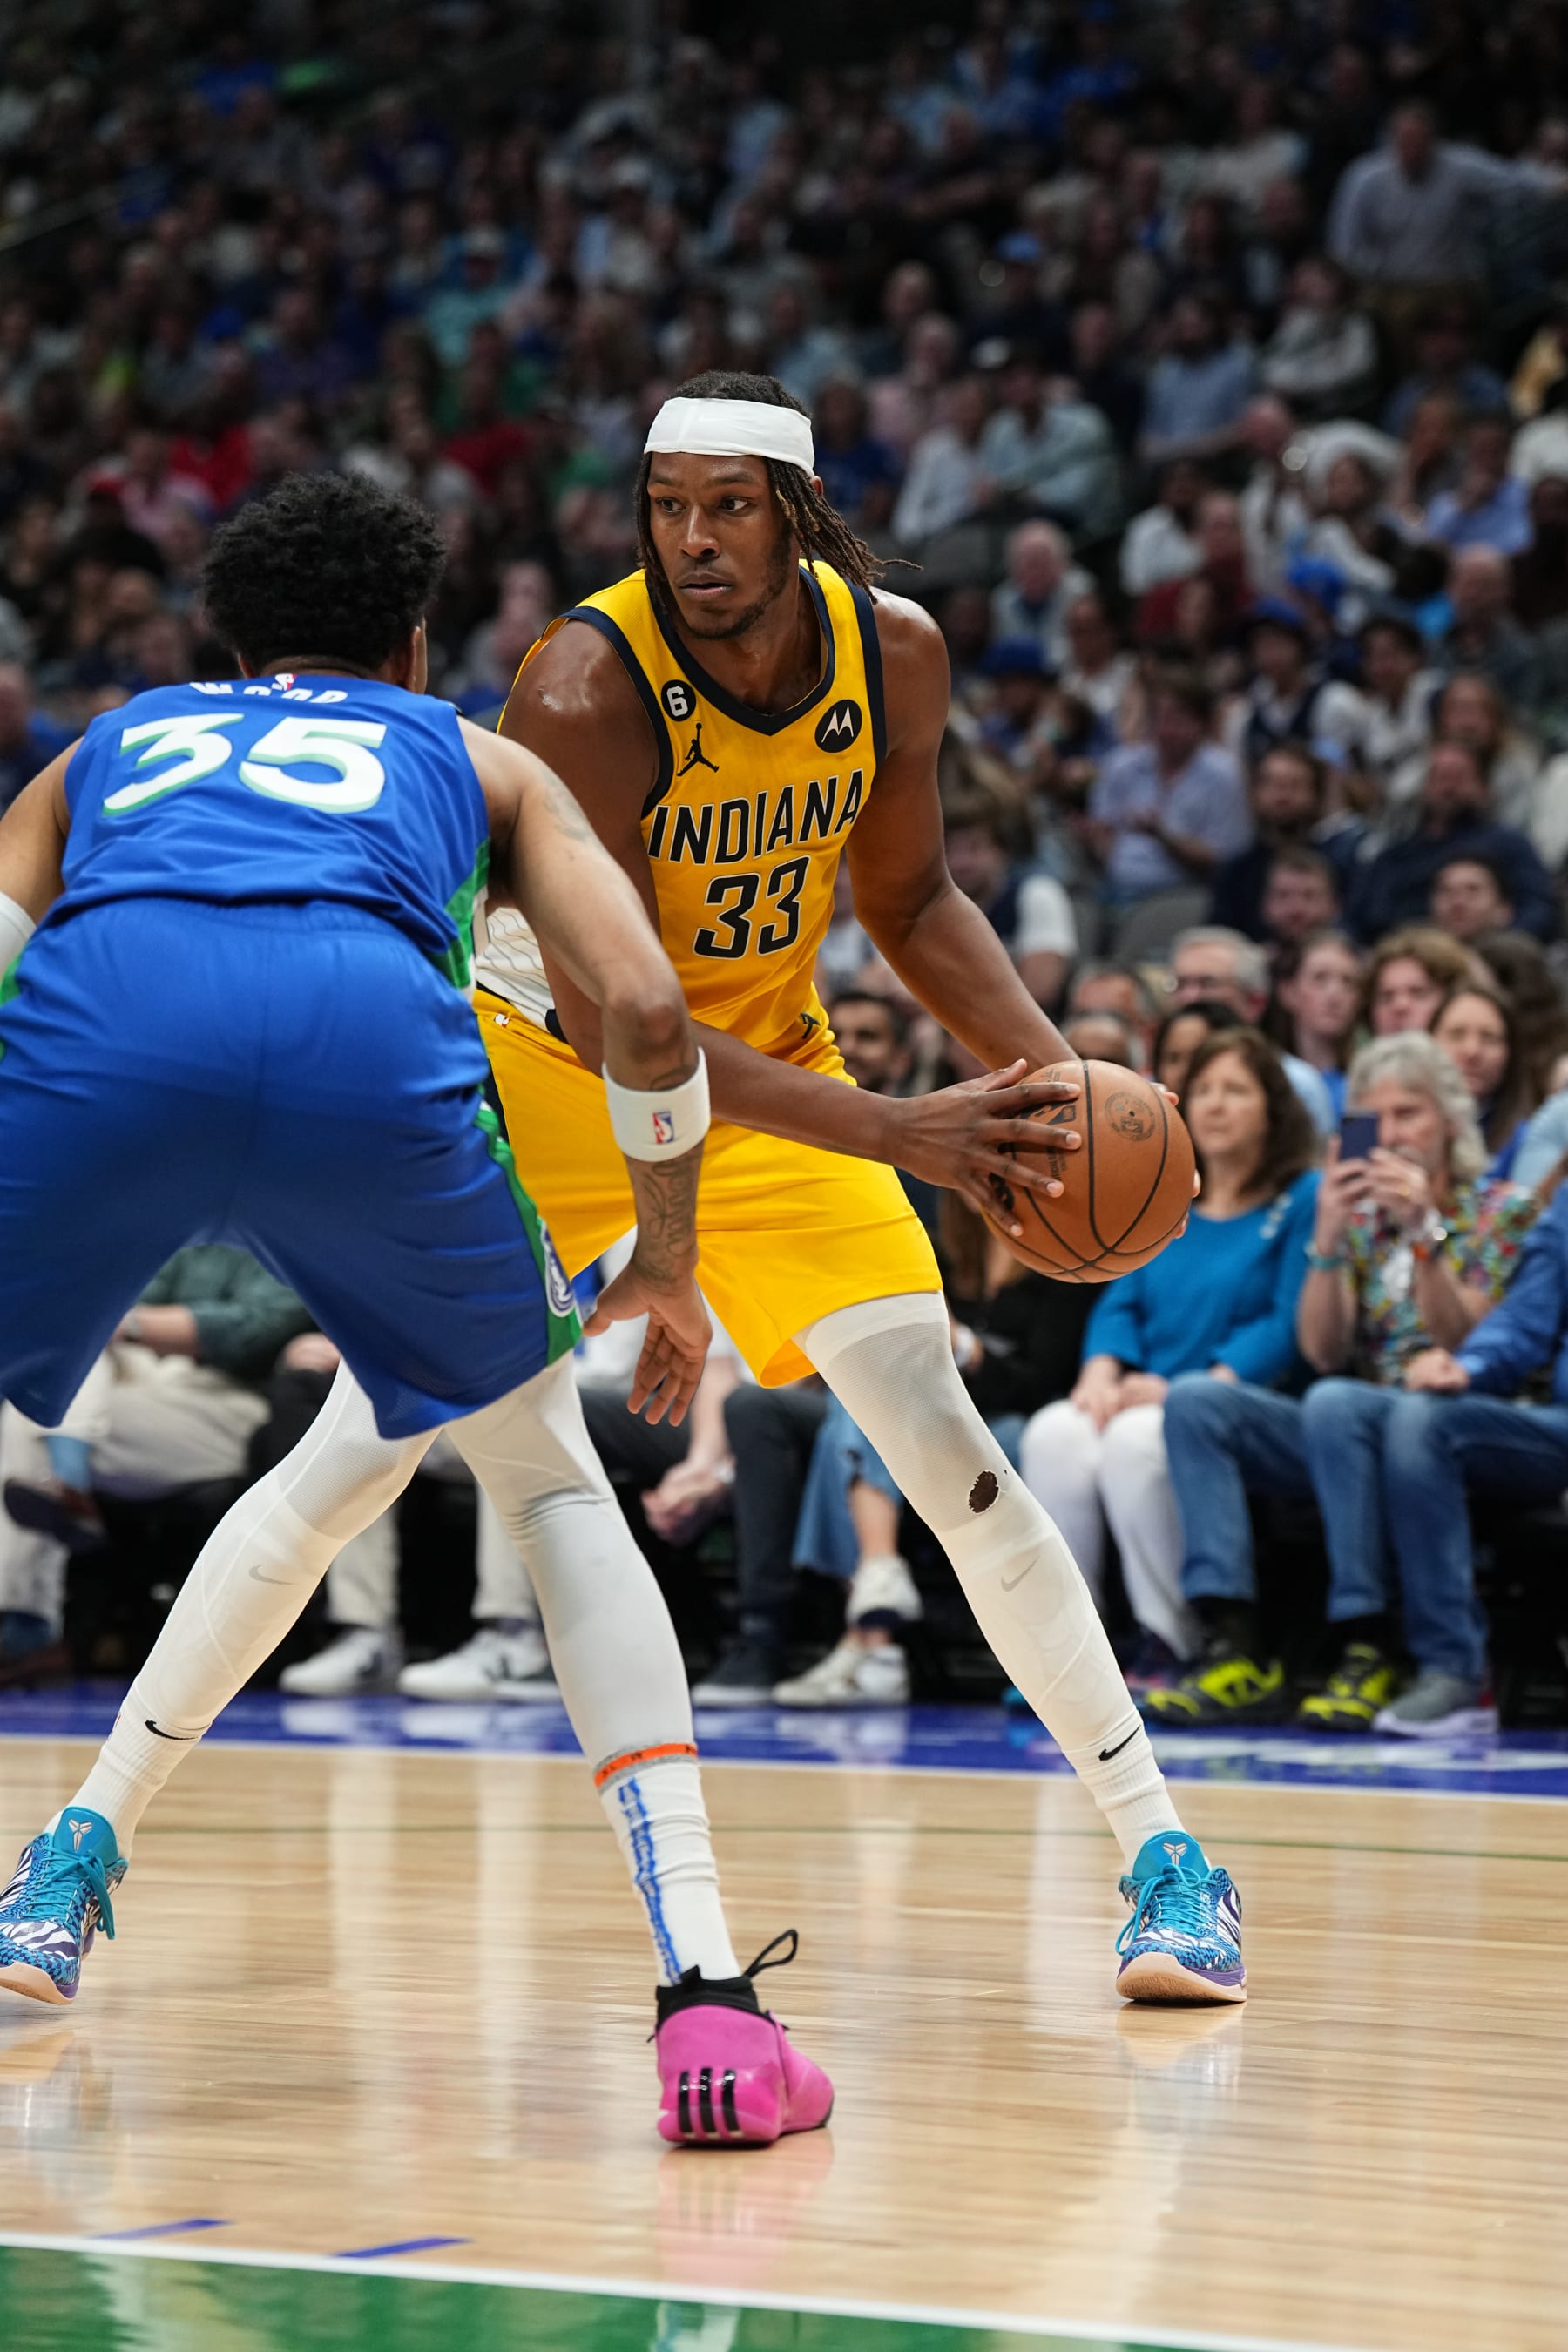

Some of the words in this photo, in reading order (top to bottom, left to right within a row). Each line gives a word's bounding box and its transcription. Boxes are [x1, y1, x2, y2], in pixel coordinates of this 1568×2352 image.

[666, 686, 688, 717] 6
[103, 713, 387, 815] 35
[647, 767, 863, 865] INDIANA
[693, 855, 811, 960] 33
